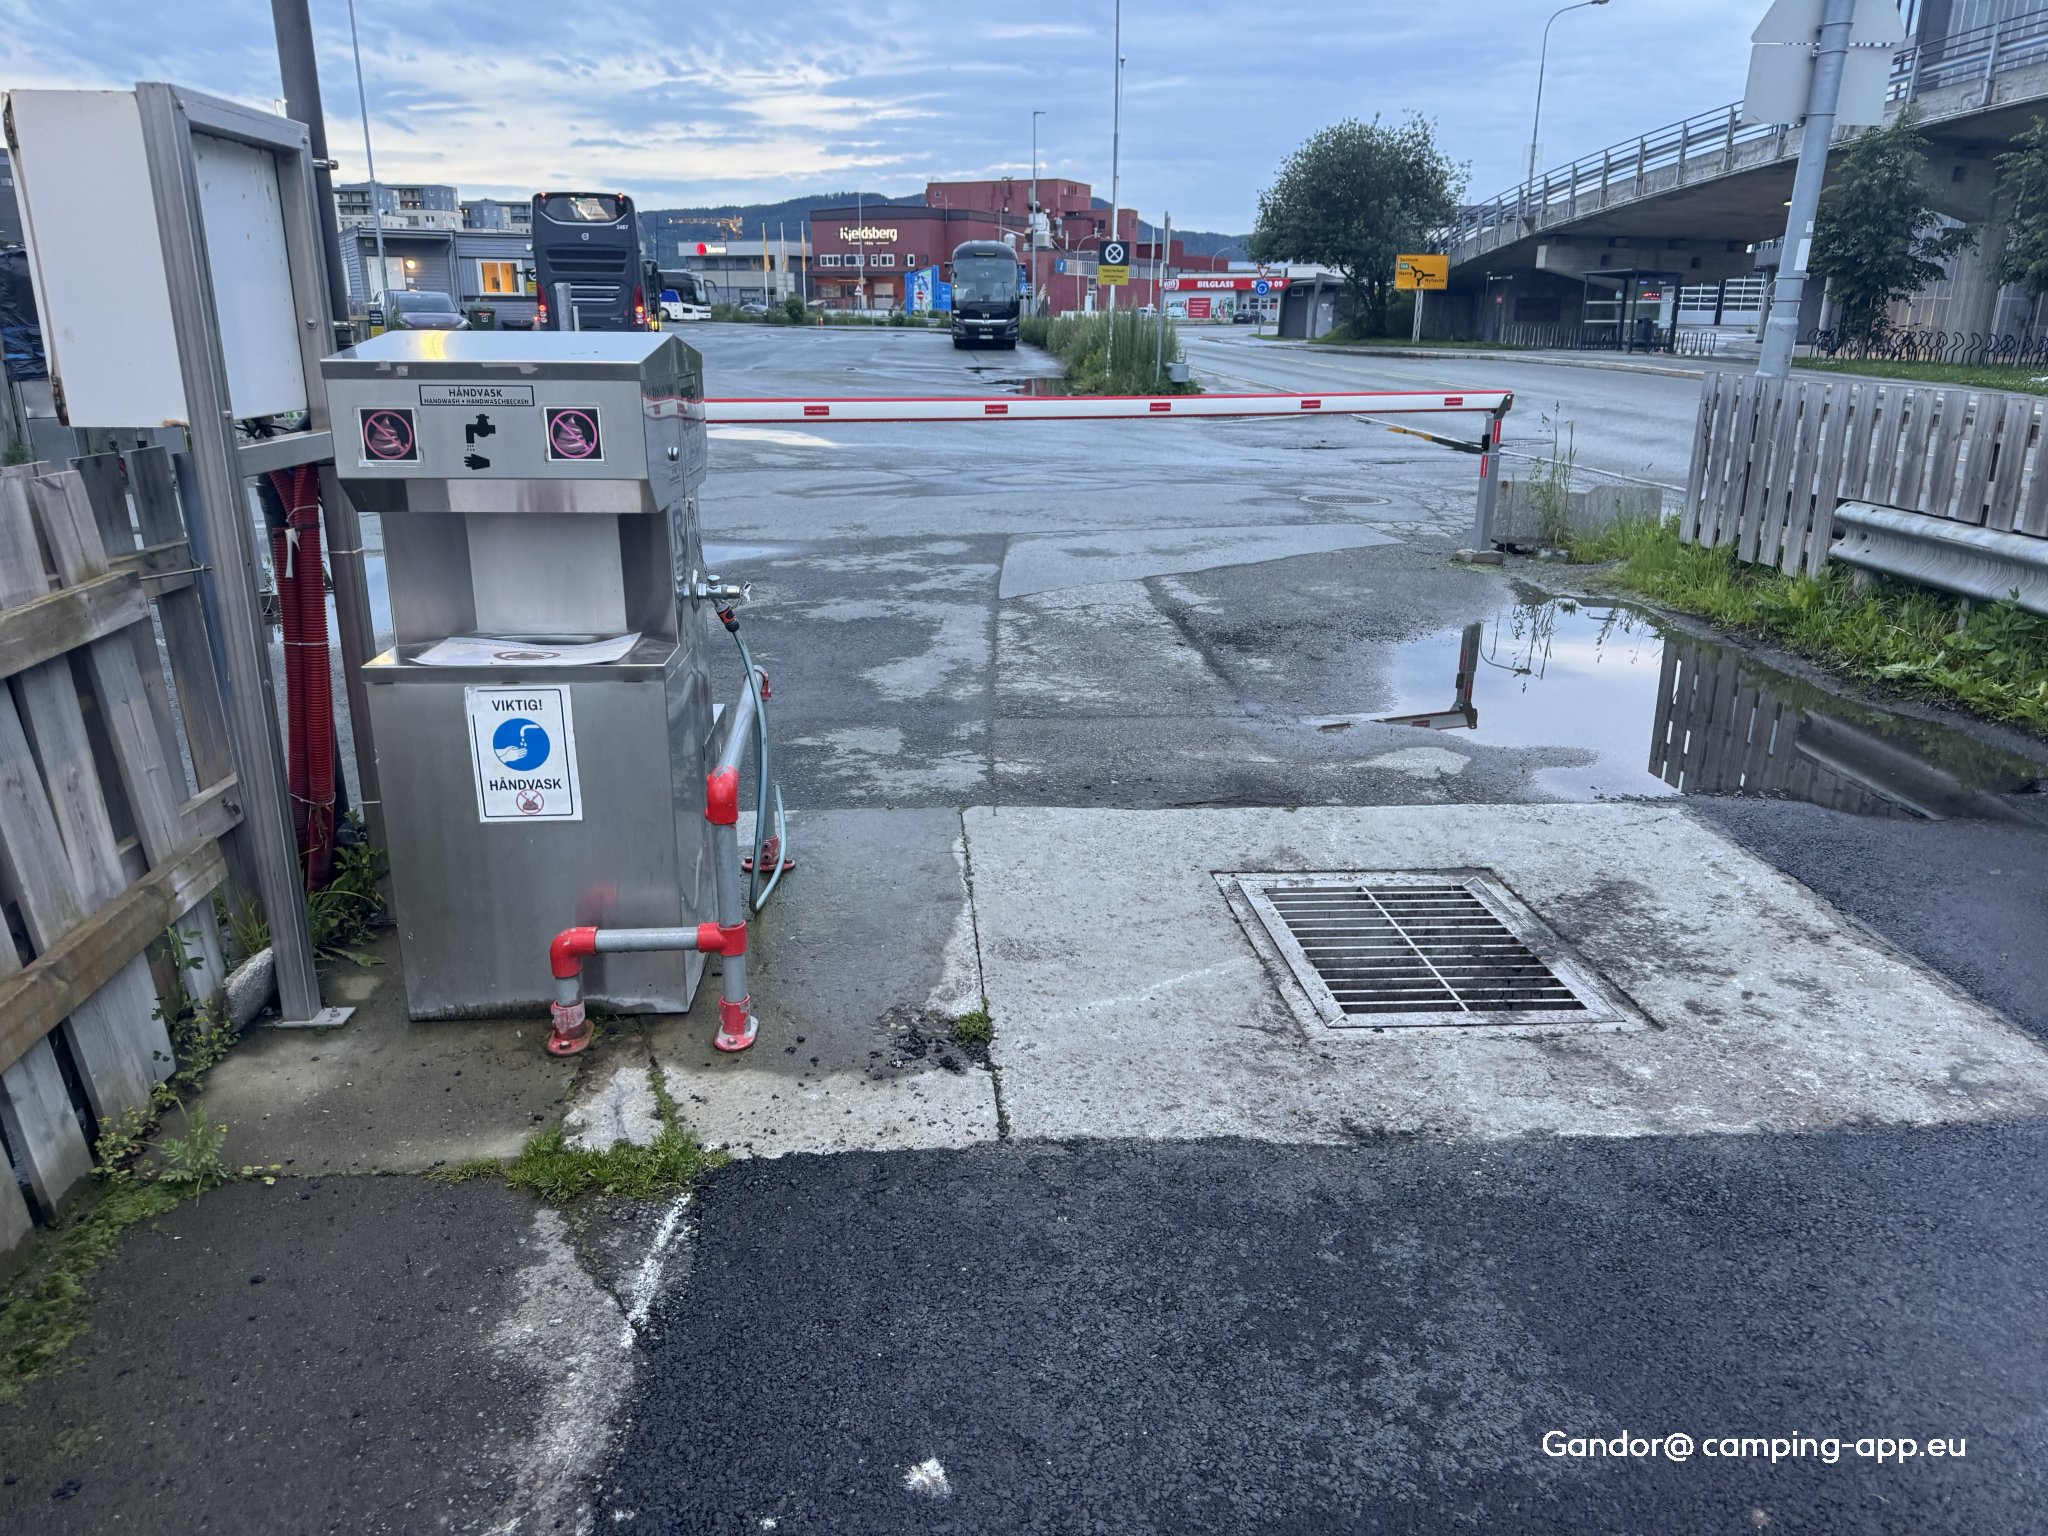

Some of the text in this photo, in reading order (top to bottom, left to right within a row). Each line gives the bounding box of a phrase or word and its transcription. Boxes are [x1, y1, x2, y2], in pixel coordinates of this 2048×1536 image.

[839, 226, 898, 242] Kjeldsberg
[1197, 280, 1235, 288] BILGLASS
[448, 387, 503, 397] HÅNDVASK
[491, 699, 543, 712] VIKTIG!
[489, 776, 562, 791] HÅNDVASK
